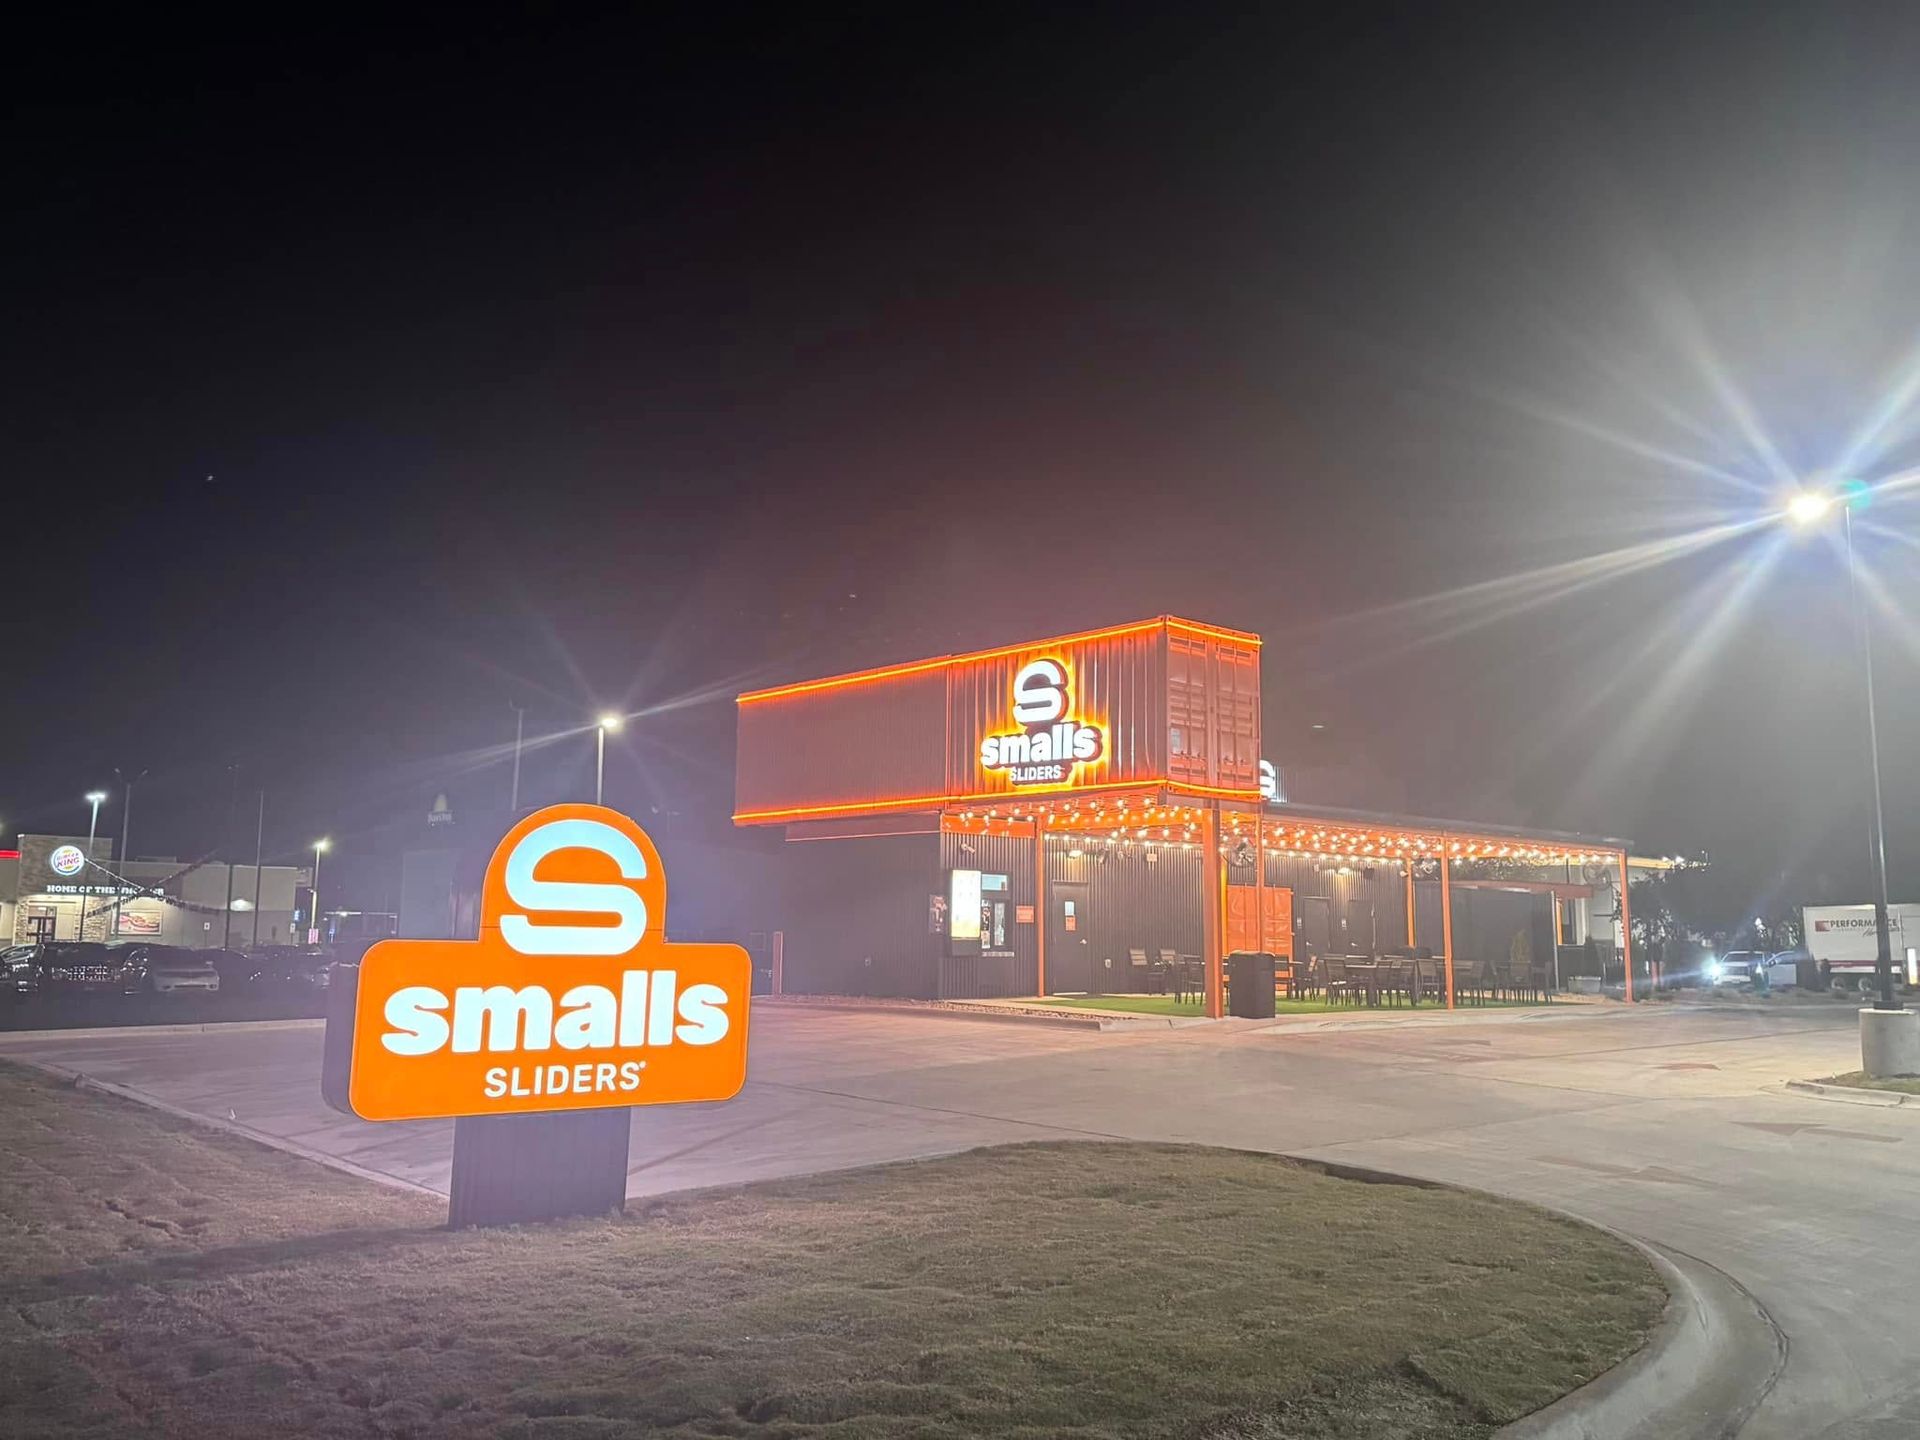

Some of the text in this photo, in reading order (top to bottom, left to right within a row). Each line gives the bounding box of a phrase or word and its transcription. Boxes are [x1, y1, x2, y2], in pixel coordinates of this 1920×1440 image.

[980, 723, 1097, 766] smalls
[1010, 764, 1062, 782] SLIDERS
[57, 857, 80, 867] KING
[46, 884, 77, 893] HOME
[78, 885, 93, 894] OF
[94, 885, 116, 894] THE
[1830, 918, 1898, 928] PERFORMACE
[380, 969, 730, 1057] smalls
[484, 1060, 644, 1099] SLIDERS
